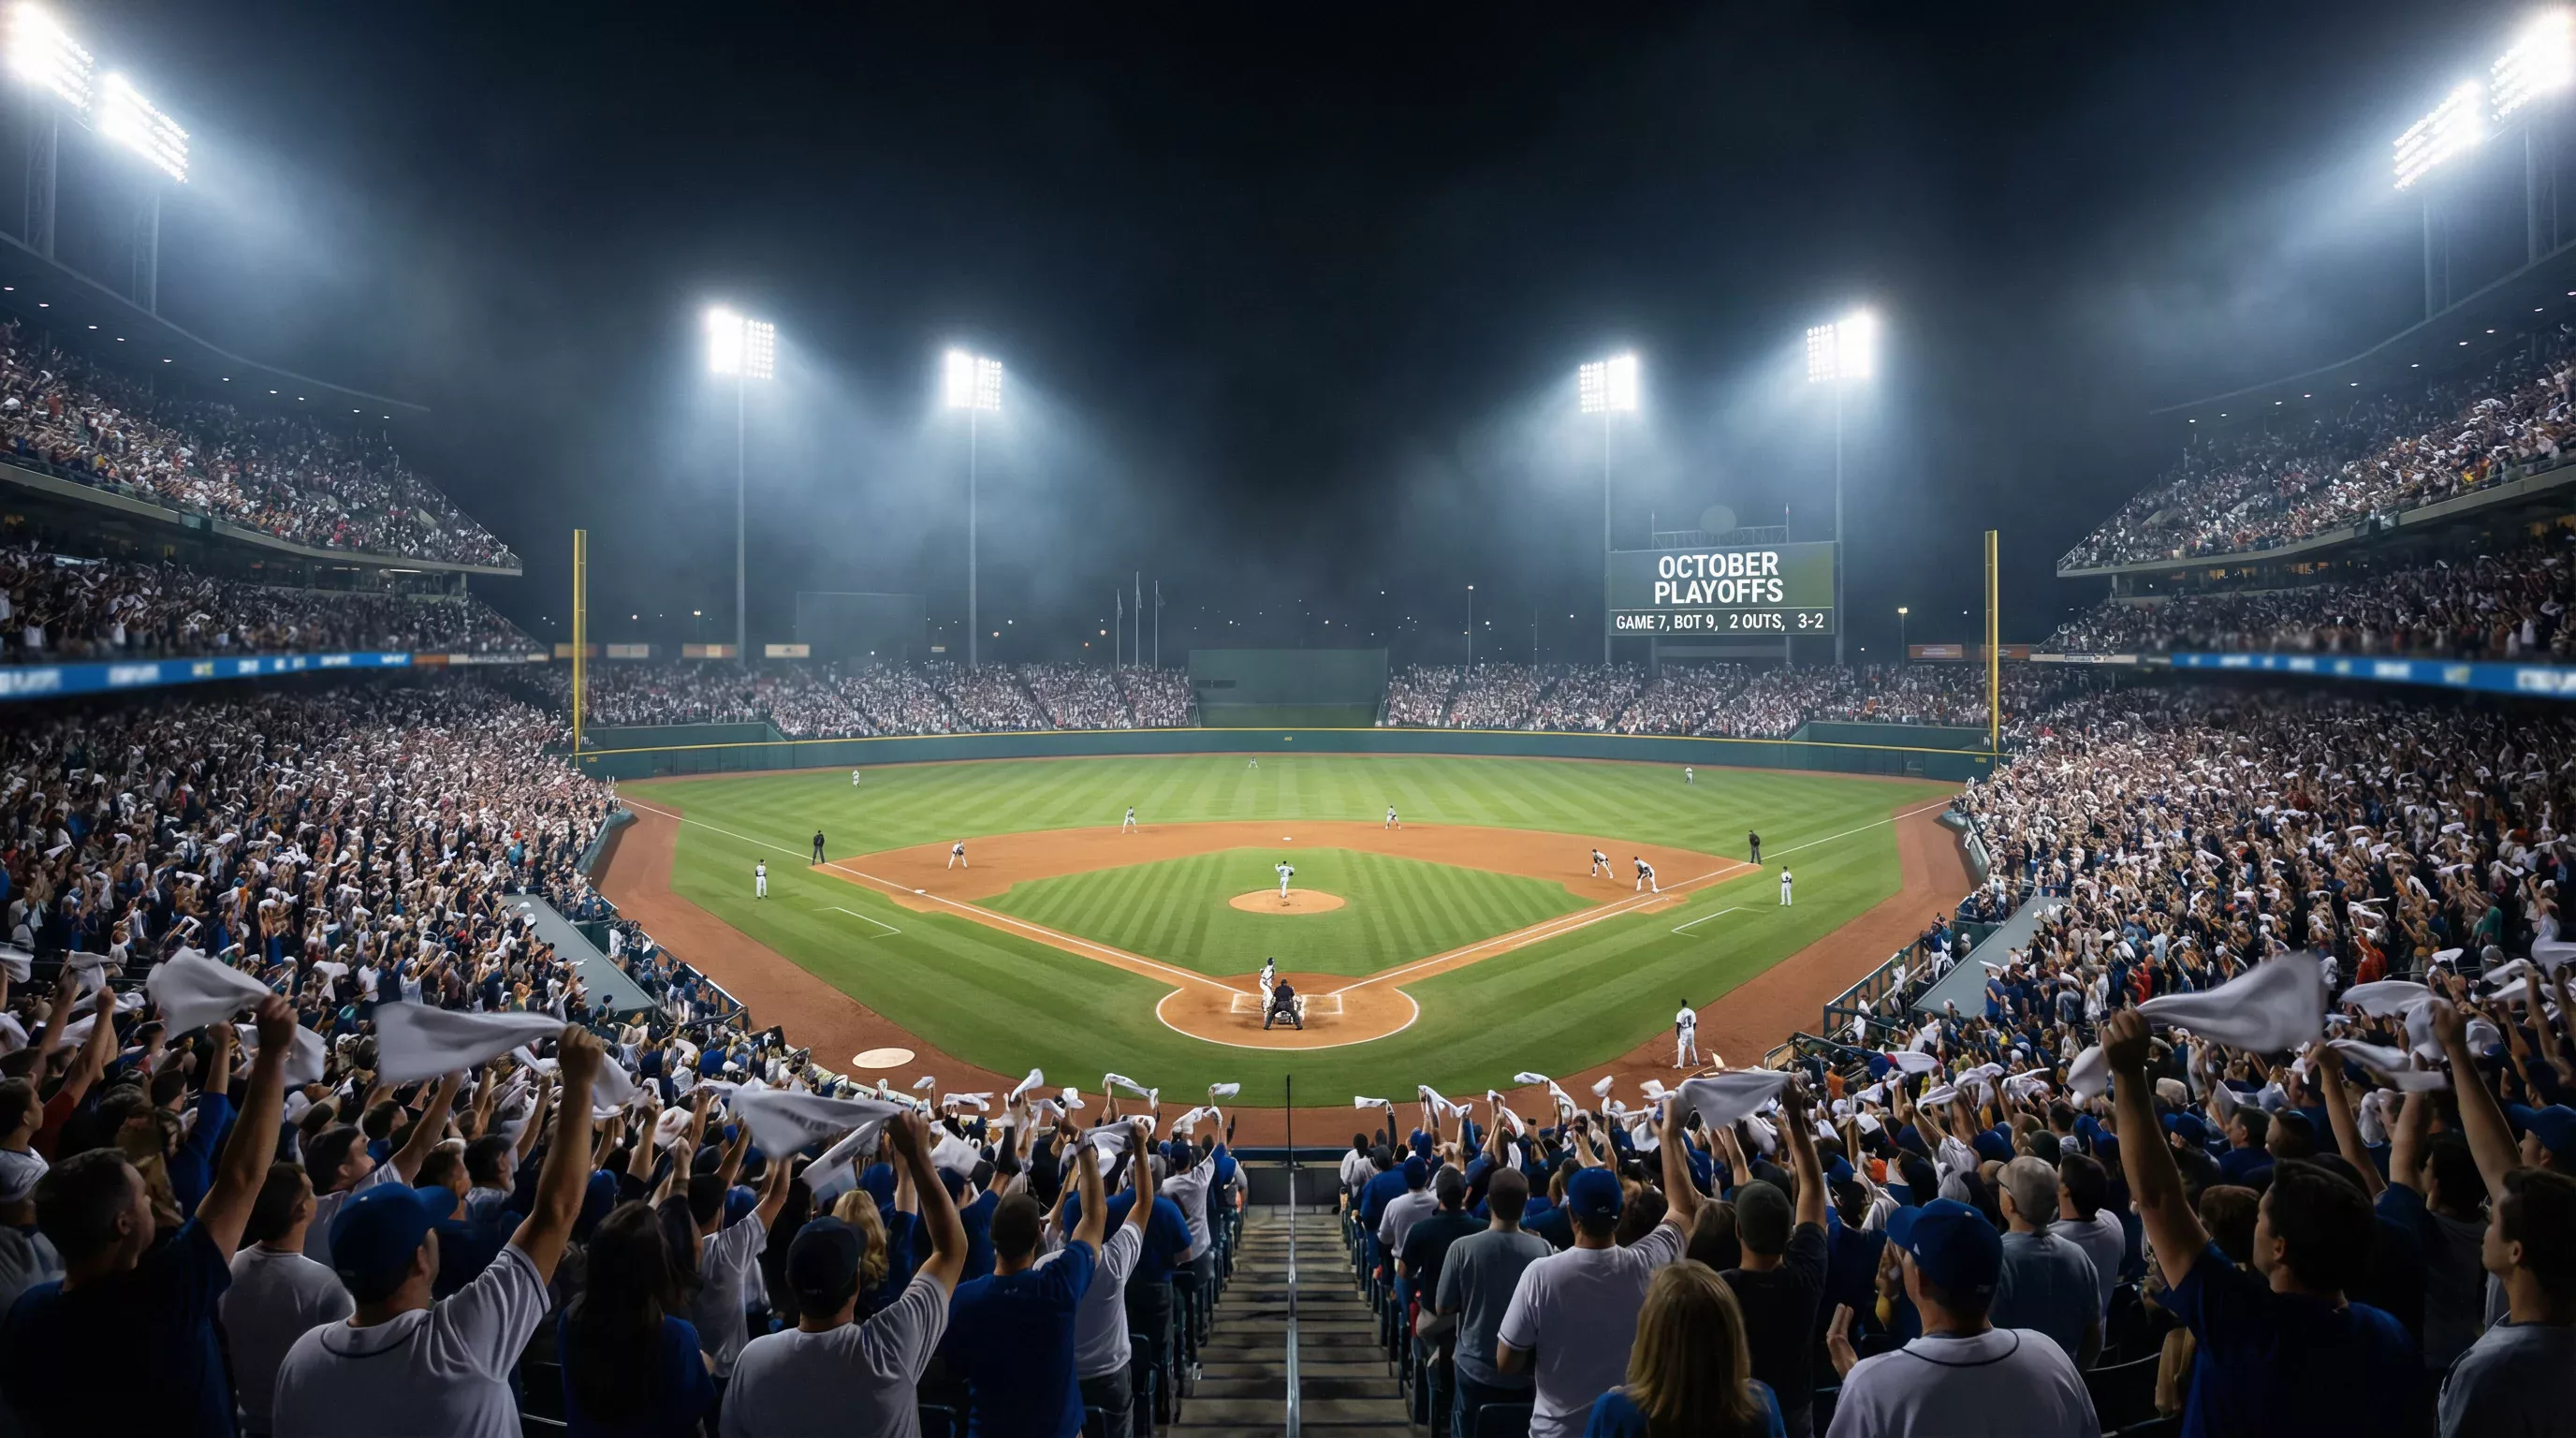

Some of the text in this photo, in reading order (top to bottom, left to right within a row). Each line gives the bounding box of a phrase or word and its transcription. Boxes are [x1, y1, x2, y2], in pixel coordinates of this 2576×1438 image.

[1658, 550, 1779, 579] OCTOBER
[1654, 578, 1784, 605] PLAYOFFS
[1616, 612, 1824, 632] GAME 7, BOT 9, 2 OUTS, 3-2
